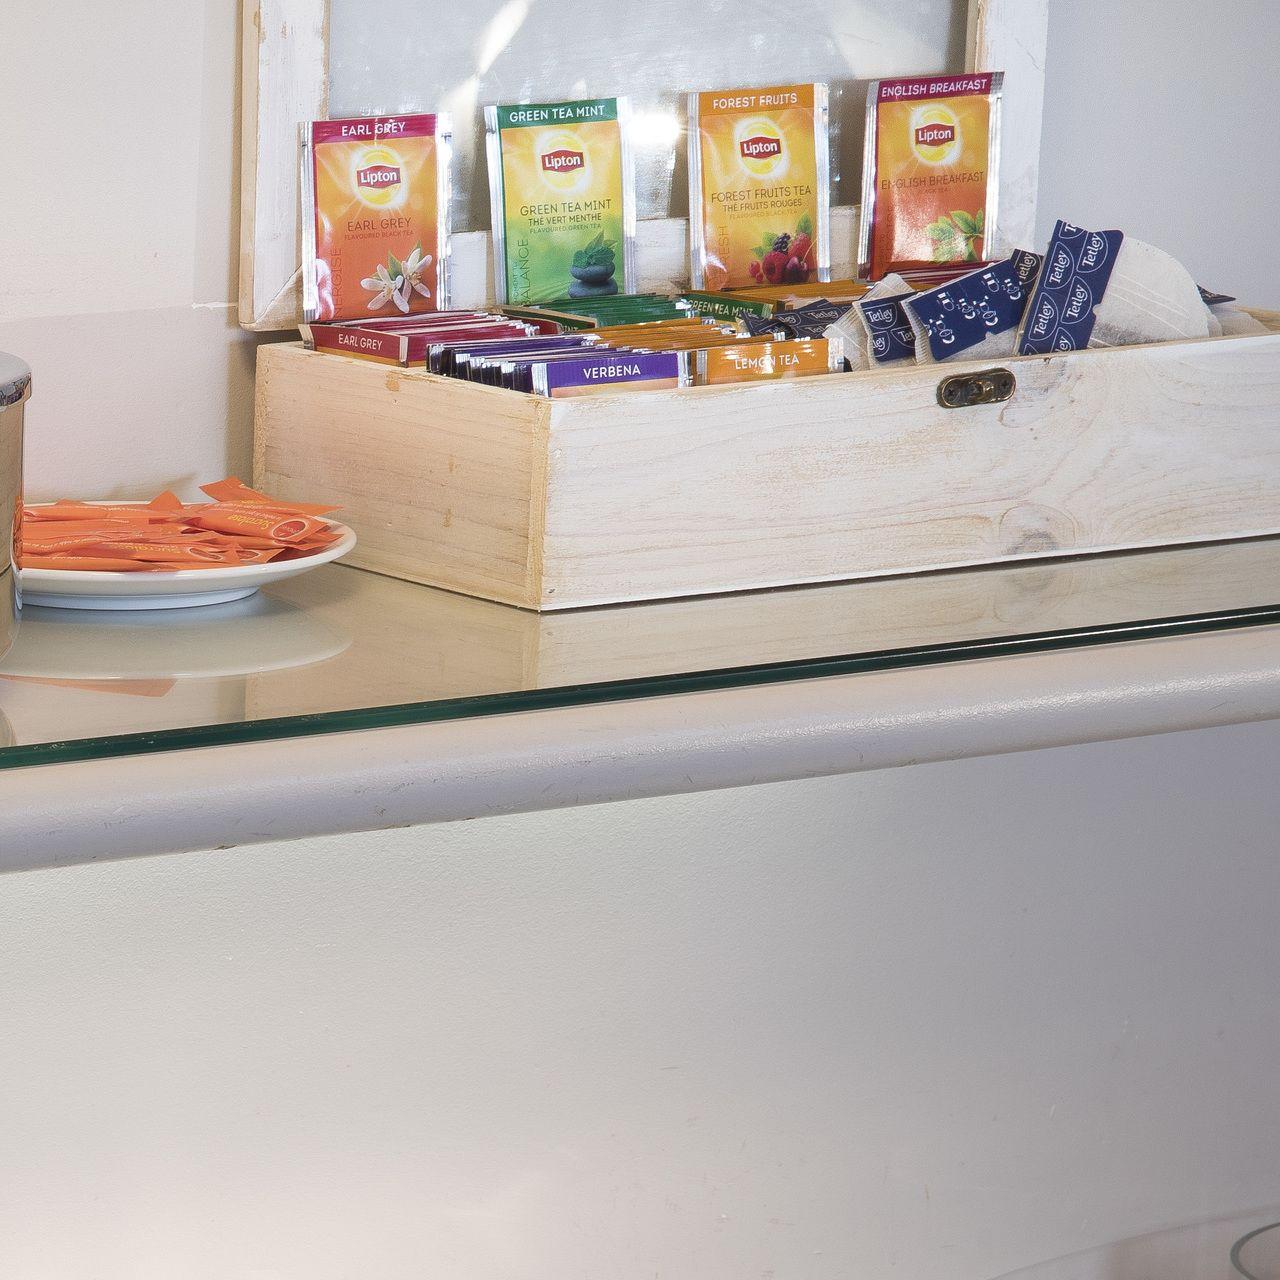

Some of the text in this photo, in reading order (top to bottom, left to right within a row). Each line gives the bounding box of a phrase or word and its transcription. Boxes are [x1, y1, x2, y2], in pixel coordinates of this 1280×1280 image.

[881, 79, 987, 98] ENGLISH BREAKFAST
[713, 93, 798, 109] FOREST FRUITS
[509, 105, 605, 122] GREEN TEA MINT
[341, 122, 406, 136] EARL GREY
[918, 128, 952, 143] Lipton
[743, 142, 778, 155] Lipton
[545, 155, 581, 169] Lipton
[360, 170, 397, 185] Lipton
[881, 171, 984, 190] ENGLISH BREAKFAST
[711, 185, 812, 203] FOREST FRUITS TEA
[520, 198, 612, 217] GREEN TEA MINT
[740, 201, 769, 211] FRUITS
[770, 199, 802, 208] ROUGES
[347, 217, 412, 232] EARL GREY
[546, 214, 567, 225] VERT
[569, 213, 602, 223] MENTHE
[1088, 232, 1105, 267] Tetley
[1049, 250, 1070, 286] Tetley
[1066, 284, 1088, 319] Tetley
[865, 309, 893, 323] Tetley
[1034, 301, 1055, 335] Tetley
[338, 333, 383, 351] EARL GREY
[779, 354, 800, 366] TEA
[583, 363, 641, 380] VERBENA
